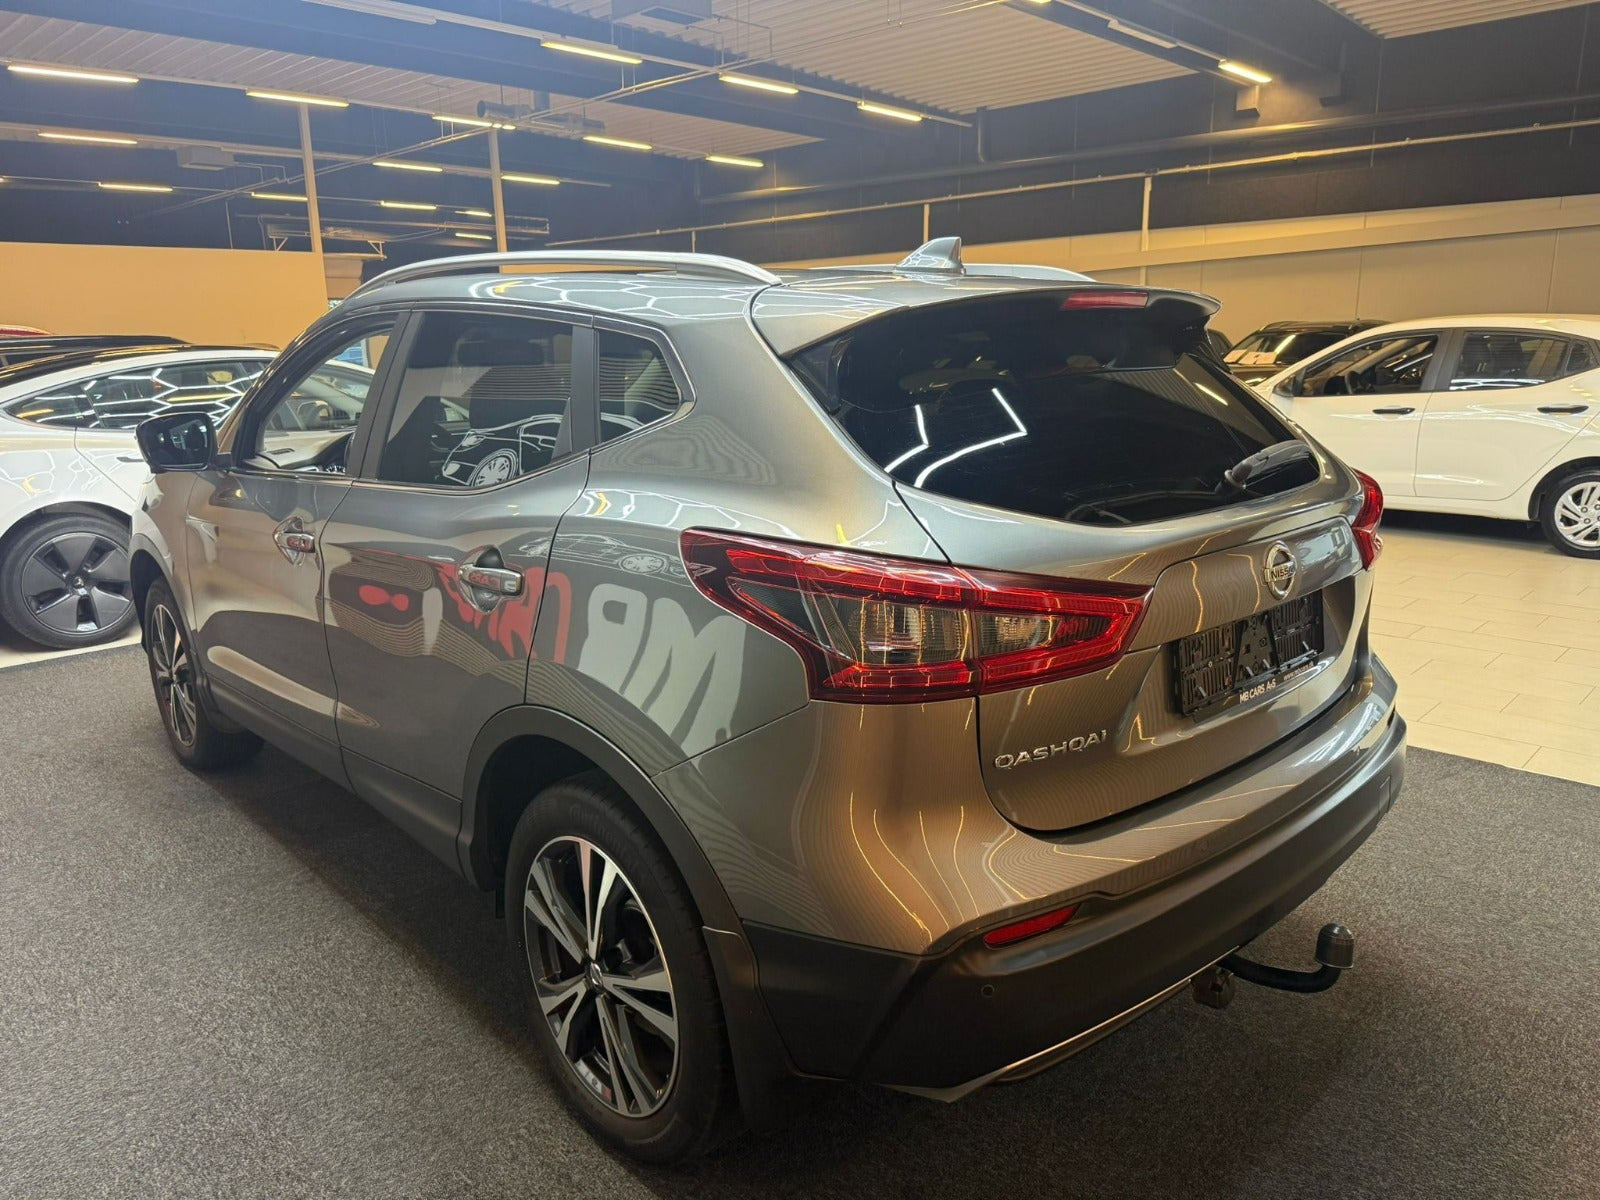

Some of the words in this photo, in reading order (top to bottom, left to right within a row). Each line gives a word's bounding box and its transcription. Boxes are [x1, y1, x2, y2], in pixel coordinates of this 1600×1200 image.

[1240, 691, 1249, 704] MB
[1249, 684, 1265, 699] CARS
[994, 729, 1107, 770] QASHQAI
